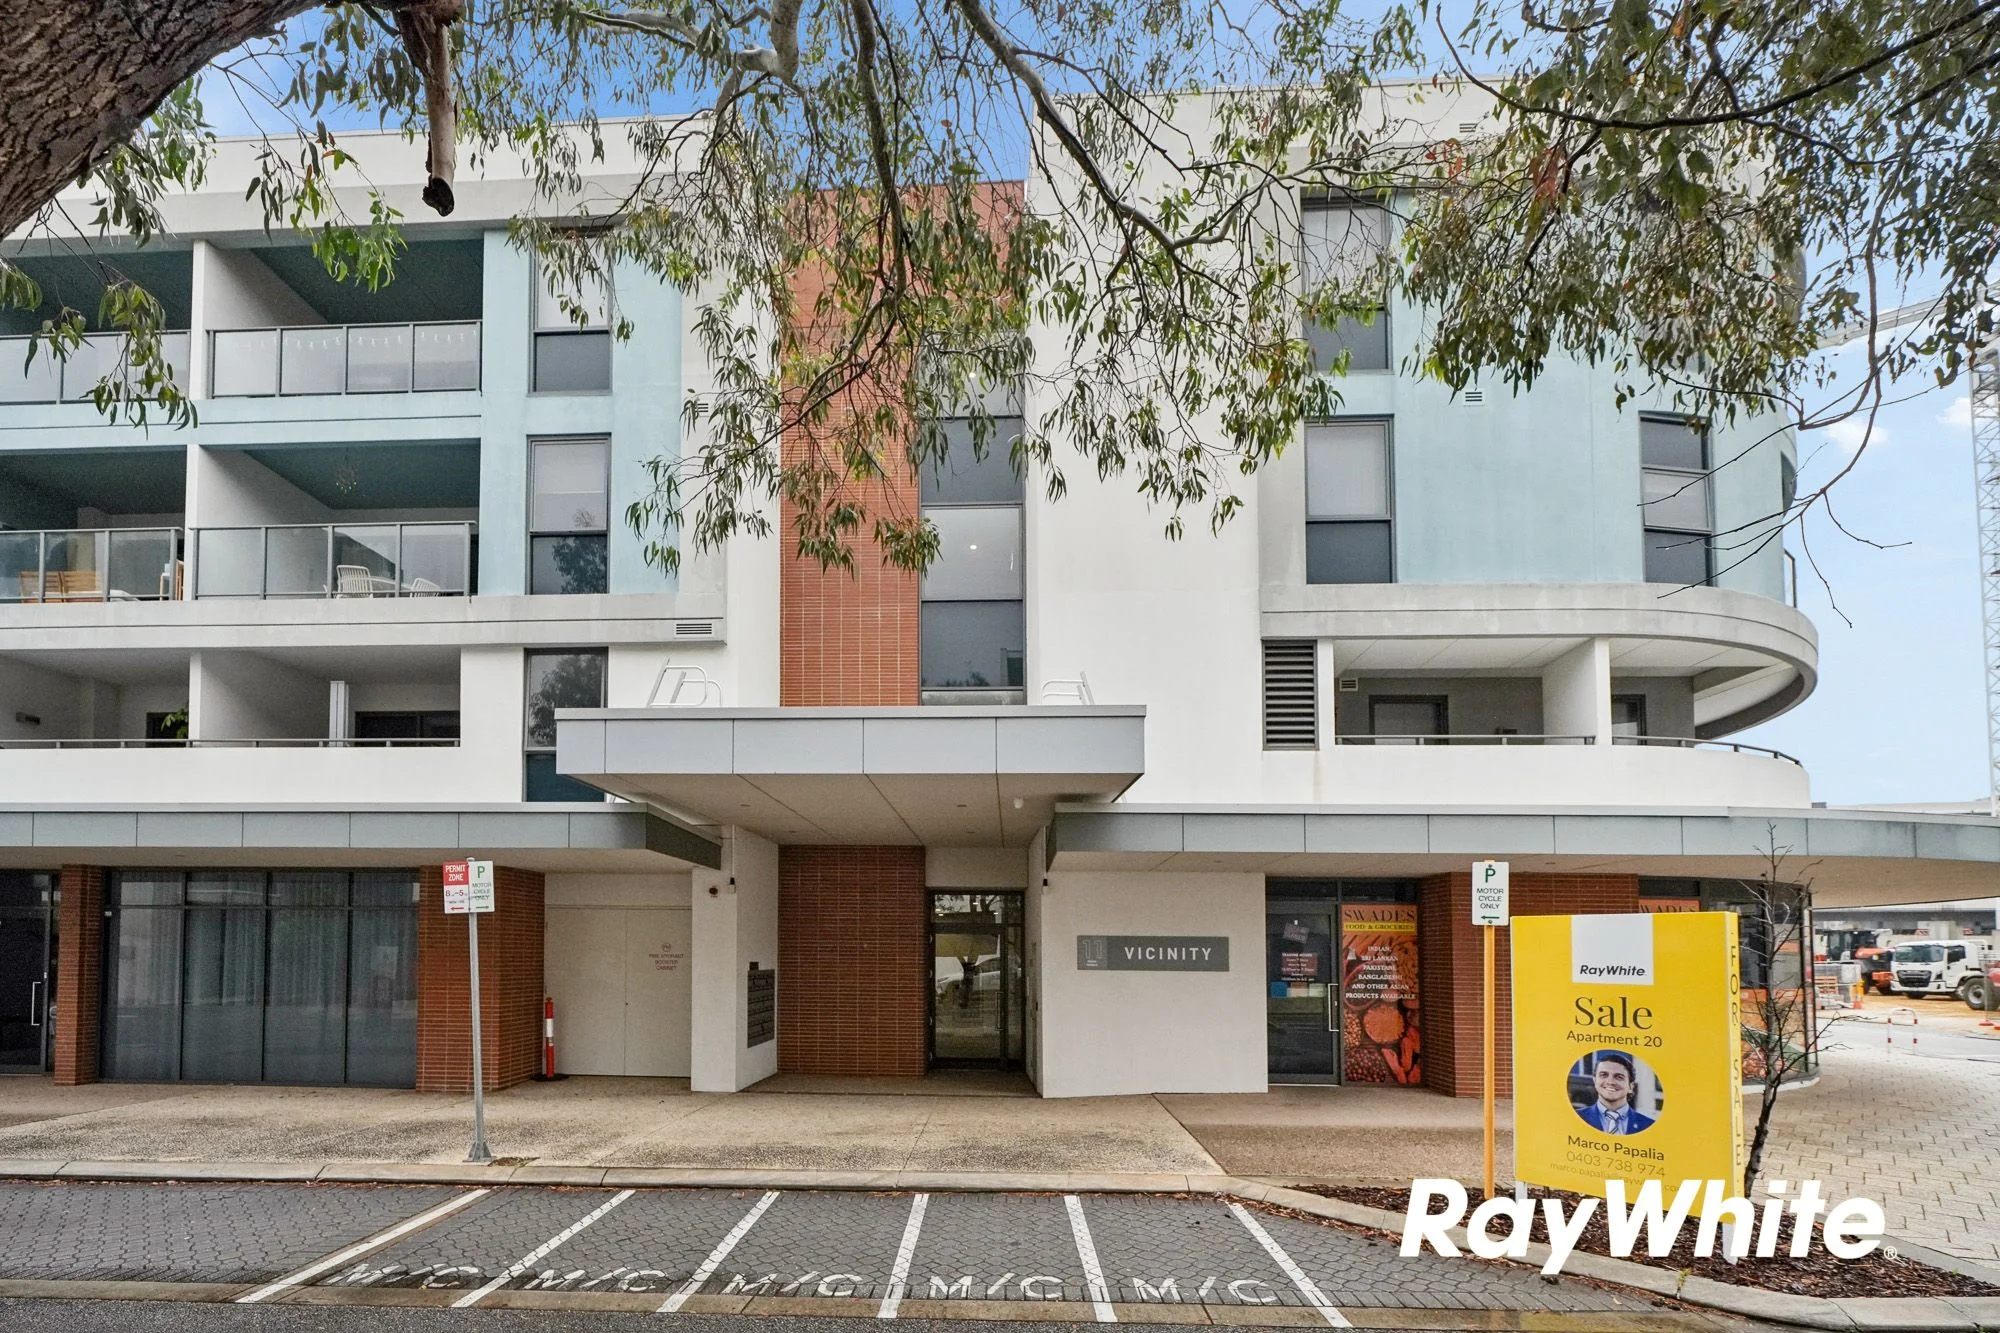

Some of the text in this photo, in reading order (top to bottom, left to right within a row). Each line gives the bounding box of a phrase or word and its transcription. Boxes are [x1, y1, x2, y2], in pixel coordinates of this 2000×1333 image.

[445, 864, 466, 873] PERMIT
[448, 873, 464, 882] ZONE
[477, 865, 486, 879] P
[1485, 868, 1496, 883] P
[1476, 887, 1504, 895] MOTOR
[1344, 909, 1415, 922] SWADES
[1124, 946, 1212, 961] VICINITY
[1579, 964, 1646, 977] RayWhite
[1575, 996, 1653, 1030] Sale
[1566, 1029, 1663, 1048] Apartment 20
[1729, 945, 1742, 1166] FOR SALE
[1567, 1134, 1665, 1161] Marco Papalia
[1566, 1150, 1667, 1178] 0403 738 974
[524, 1266, 668, 1291] M/C
[721, 1270, 863, 1296] M/C
[929, 1272, 1063, 1298] M/C
[1132, 1275, 1278, 1303] M/C
